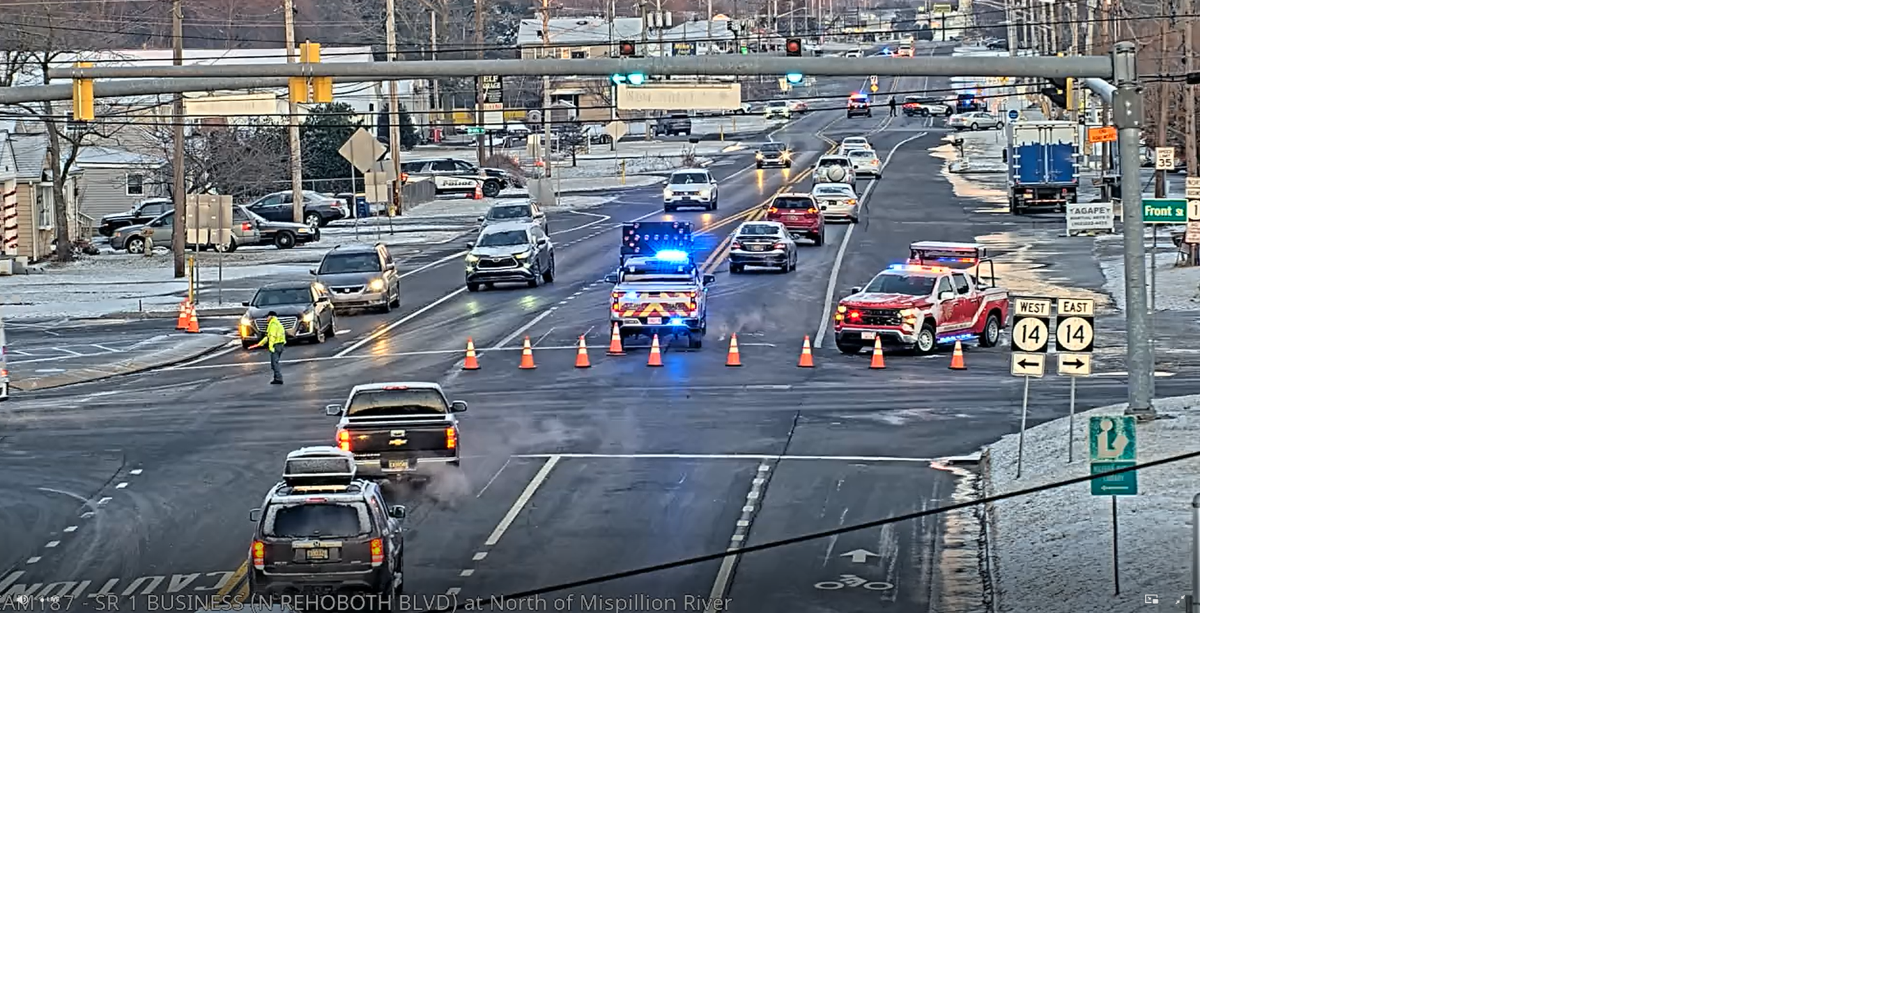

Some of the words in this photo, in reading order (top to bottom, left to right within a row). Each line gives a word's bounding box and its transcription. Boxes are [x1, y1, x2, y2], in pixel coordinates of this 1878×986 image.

[1159, 159, 1172, 167] 35
[1145, 205, 1172, 216] Front
[1020, 302, 1045, 313] WEST
[1063, 302, 1088, 312] EAST
[1022, 325, 1040, 343] 14
[1066, 325, 1084, 343] 14
